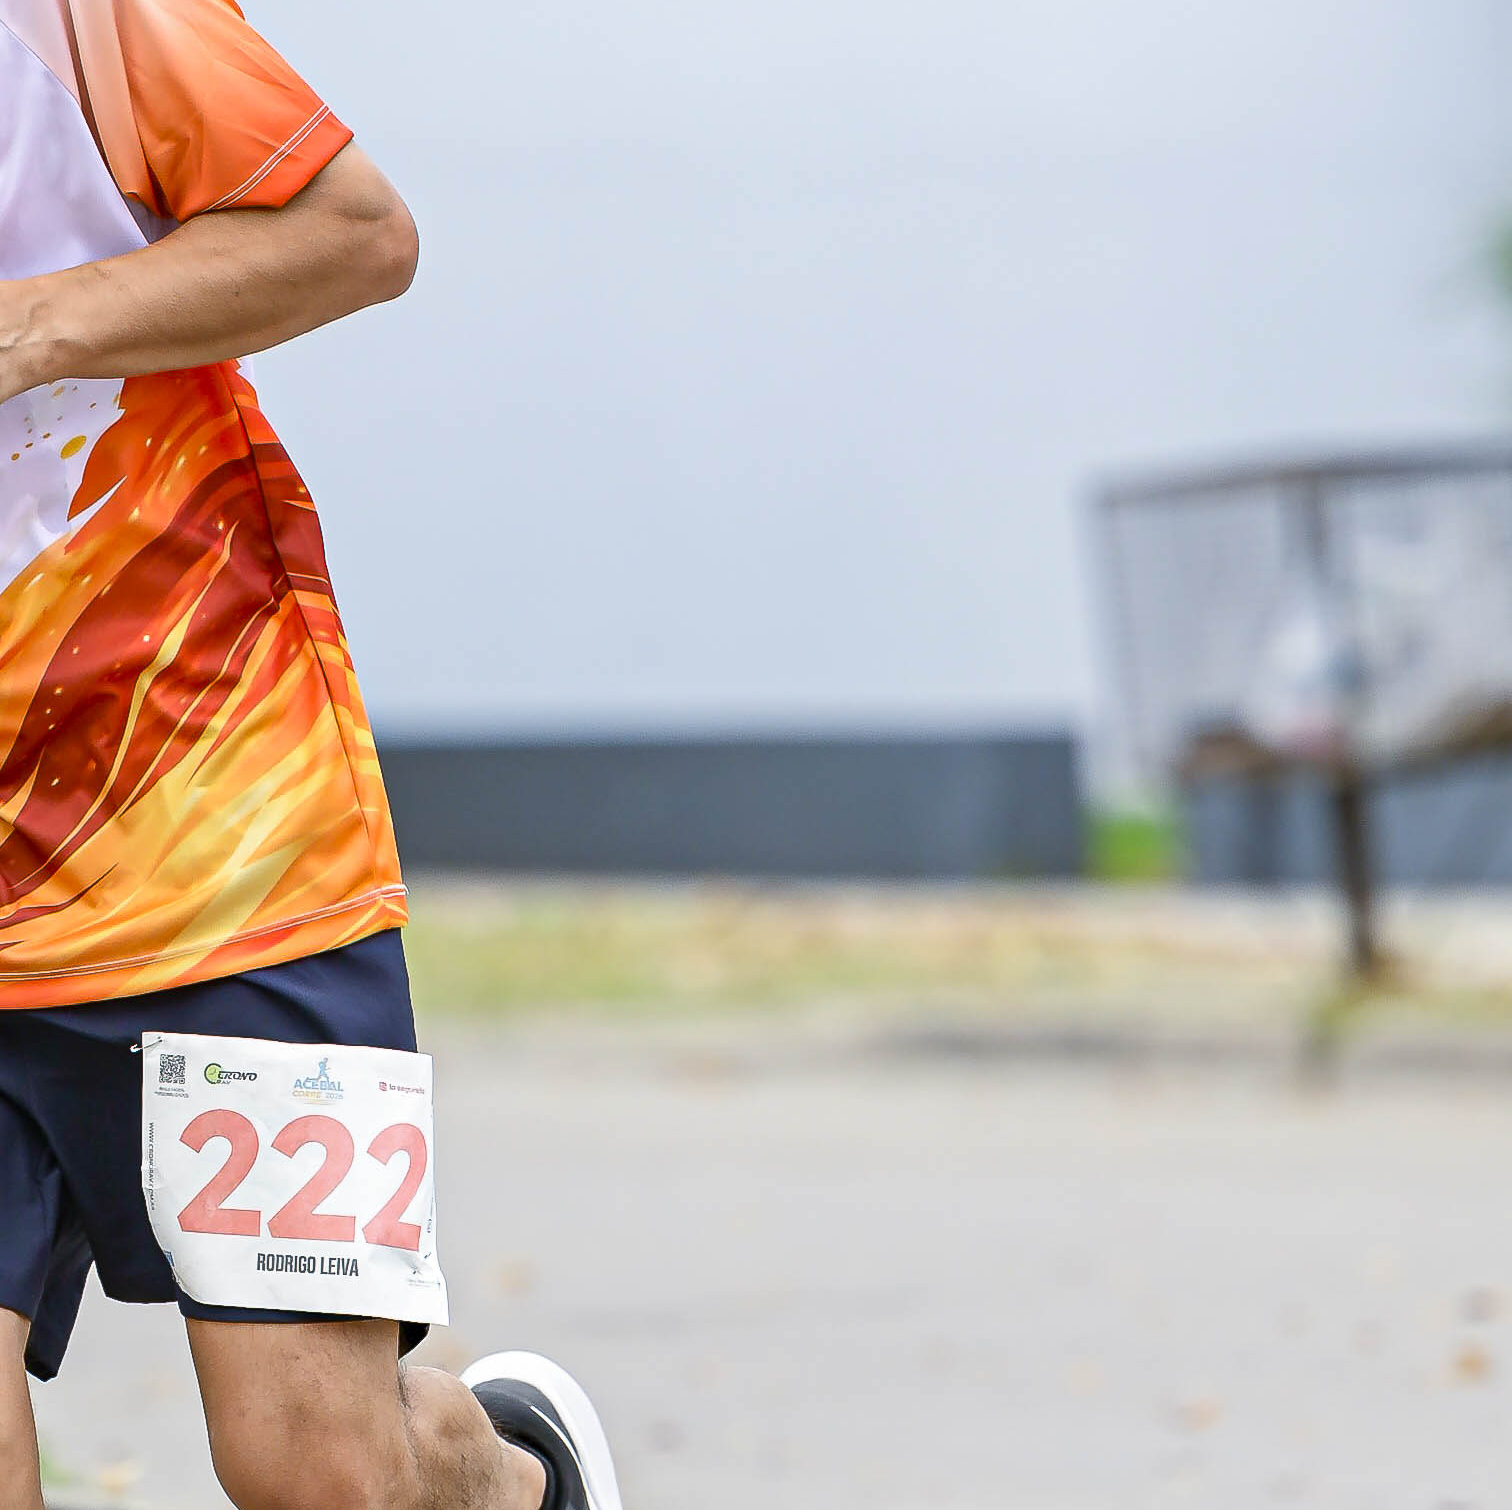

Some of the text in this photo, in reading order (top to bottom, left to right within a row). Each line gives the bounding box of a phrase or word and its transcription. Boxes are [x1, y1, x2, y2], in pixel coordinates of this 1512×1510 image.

[293, 1076, 345, 1092] ACEBAL
[291, 1090, 322, 1099] CORRE
[176, 1108, 428, 1252] 222
[256, 1252, 360, 1277] RODRIGO LEIVA
